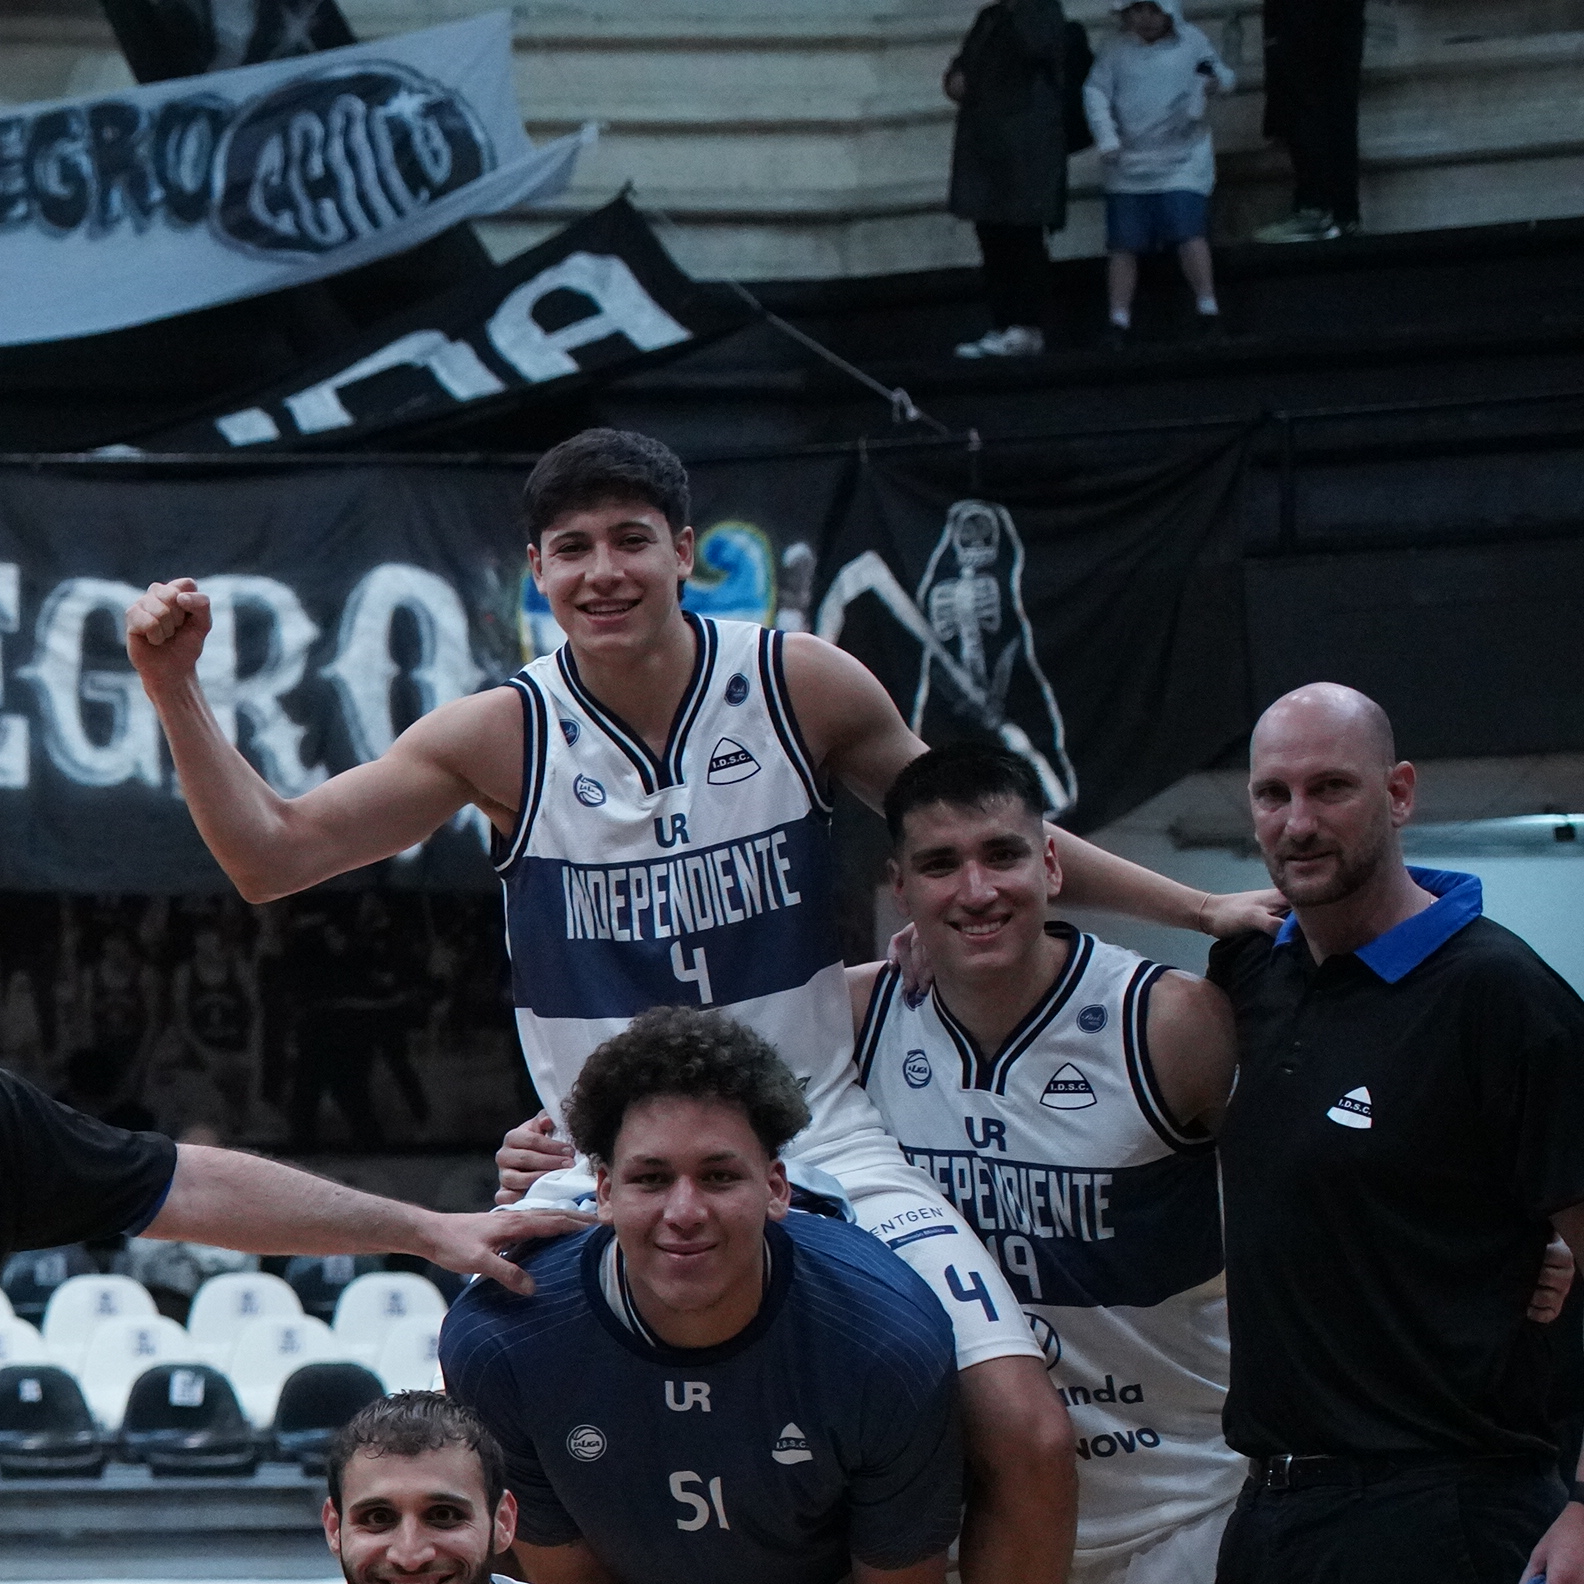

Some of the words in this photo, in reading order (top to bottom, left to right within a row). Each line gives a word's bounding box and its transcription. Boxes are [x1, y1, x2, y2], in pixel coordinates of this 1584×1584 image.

[711, 751, 751, 770] I.D.S.C.
[653, 812, 691, 849] UR
[561, 830, 802, 942] INDEPENDIENTE
[668, 940, 714, 1005] 4
[1049, 1082, 1090, 1092] I.D.S.C.
[1338, 1098, 1372, 1115] I.D.S.C.
[964, 1116, 1007, 1153] UR
[868, 1206, 944, 1239] ENTGEN
[943, 1263, 1000, 1323] 4
[664, 1380, 711, 1412] UR
[668, 1470, 731, 1532] 51
